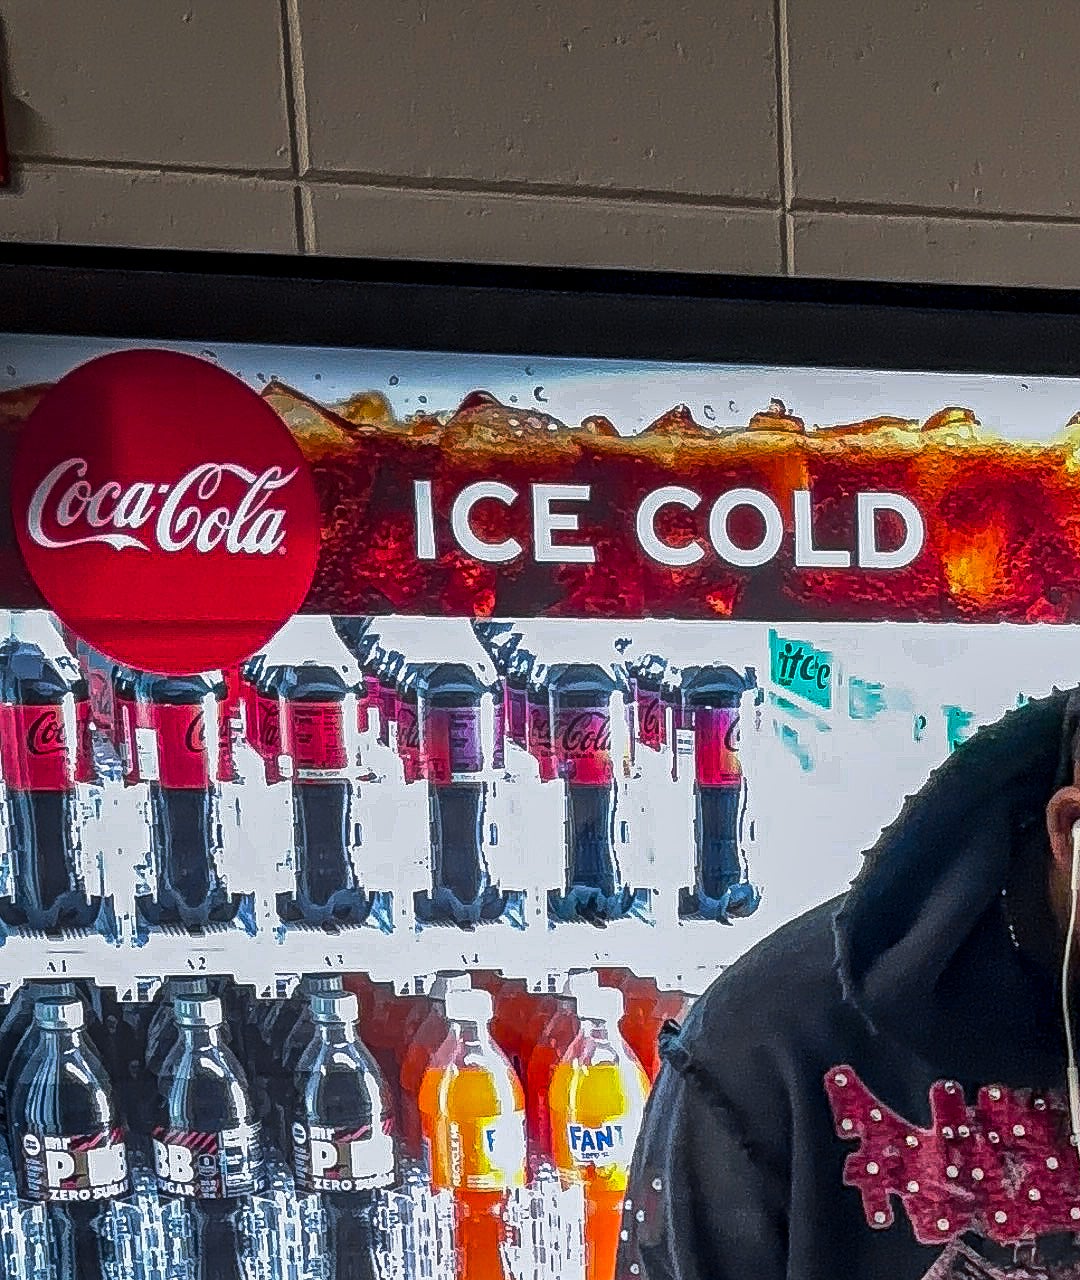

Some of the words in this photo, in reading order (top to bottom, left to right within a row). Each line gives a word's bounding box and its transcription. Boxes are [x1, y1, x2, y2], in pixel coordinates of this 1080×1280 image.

[27, 457, 299, 556] Coca-Cola
[413, 479, 596, 563] ICE
[636, 485, 925, 571] COLD
[569, 1125, 624, 1152] FANT
[49, 1189, 93, 1201] ZERO
